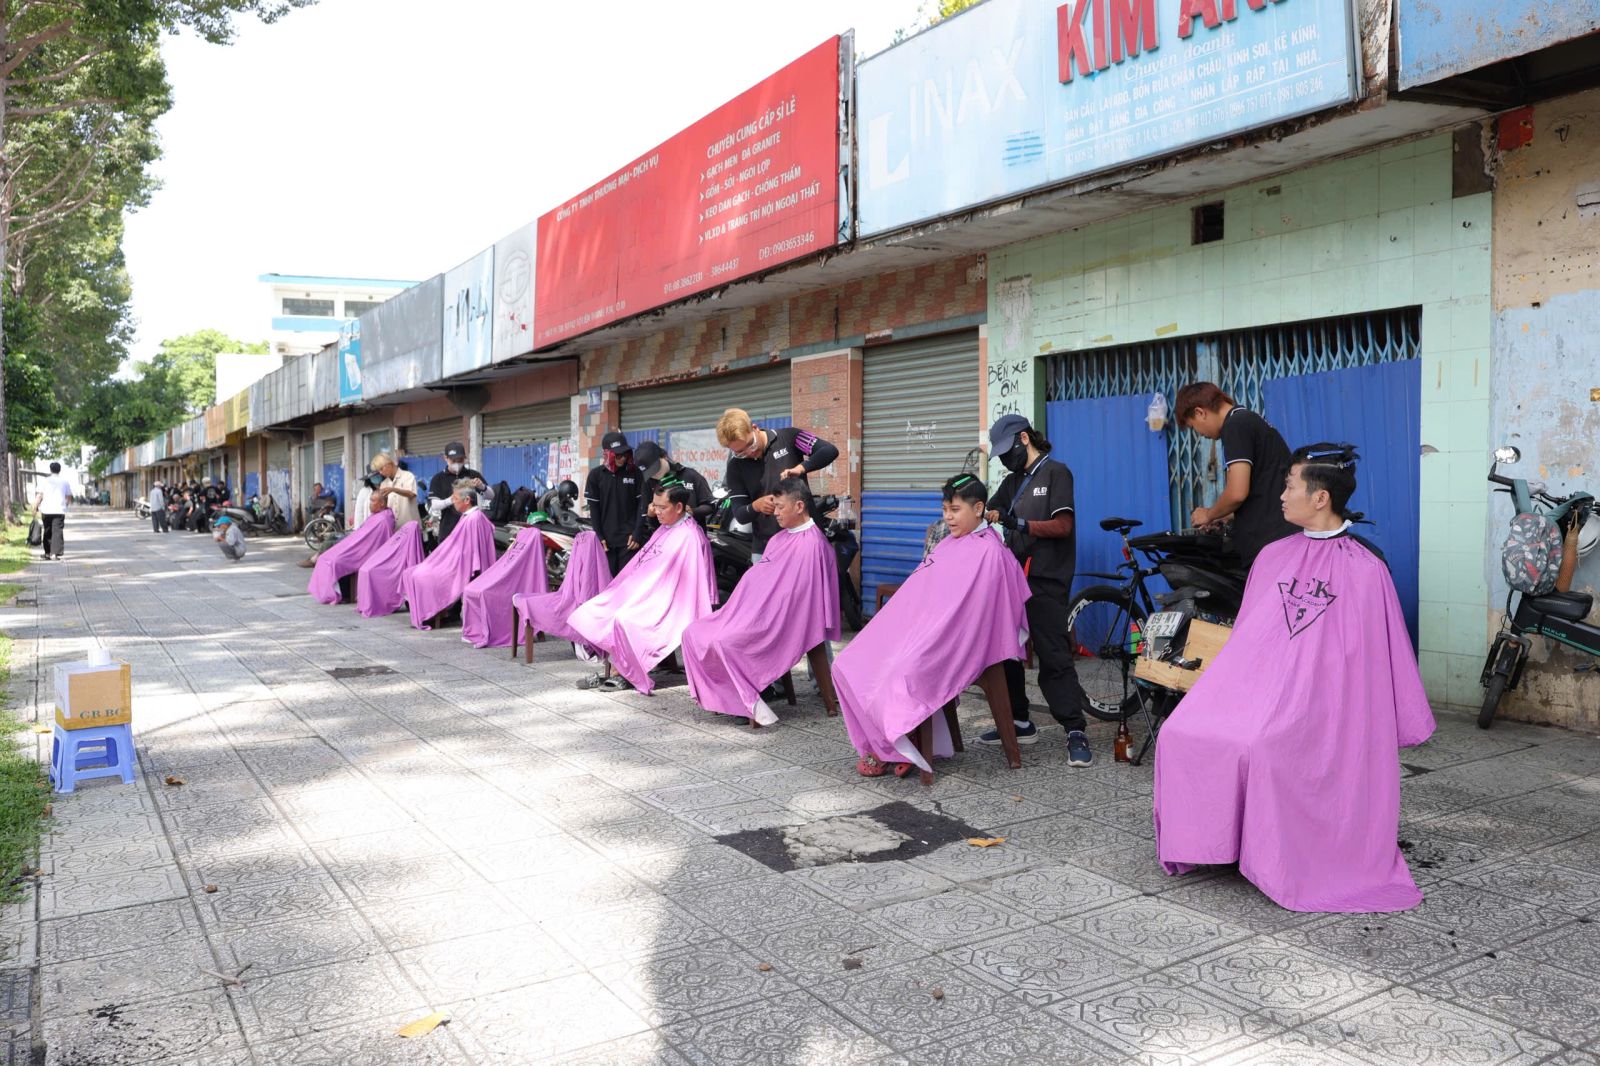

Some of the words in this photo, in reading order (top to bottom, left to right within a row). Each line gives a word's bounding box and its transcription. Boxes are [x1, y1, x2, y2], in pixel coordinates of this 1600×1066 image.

[1057, 0, 1160, 84] KIM
[736, 121, 758, 142] CUNG
[724, 154, 739, 170] MEN
[752, 131, 781, 155] GRANITE
[727, 213, 749, 231] TRANG
[1012, 360, 1028, 375] XE
